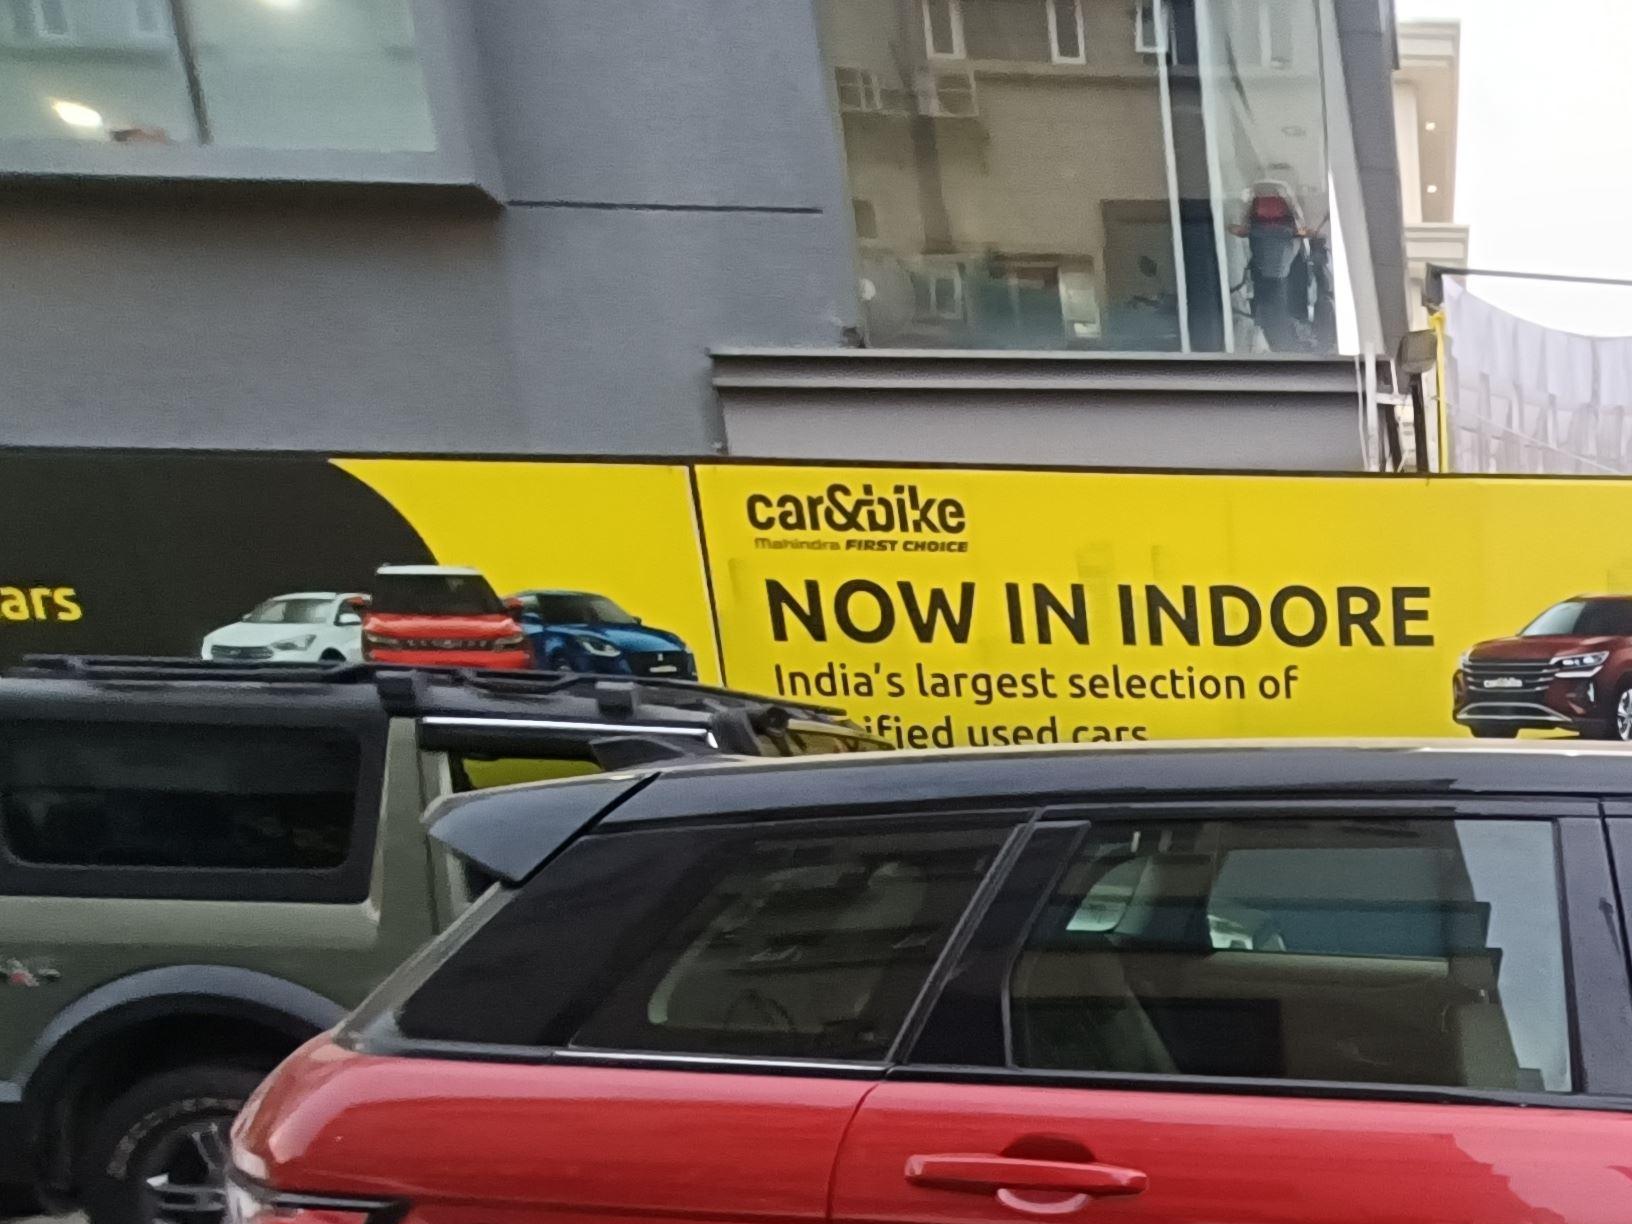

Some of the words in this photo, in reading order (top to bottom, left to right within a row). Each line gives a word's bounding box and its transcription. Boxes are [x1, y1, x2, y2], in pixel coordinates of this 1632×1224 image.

[747, 483, 966, 534] car&bike
[845, 540, 898, 551] FIRST
[902, 540, 969, 552] CHOICE
[0, 586, 82, 621] ars
[765, 579, 976, 644] NOW
[1005, 582, 1091, 646] IN
[1118, 584, 1434, 646] INDORE
[775, 662, 905, 697] India's
[915, 663, 1058, 705] largest
[1068, 664, 1245, 699] selection
[1258, 665, 1299, 699] of
[863, 715, 954, 749] ified
[967, 715, 1058, 746] used
